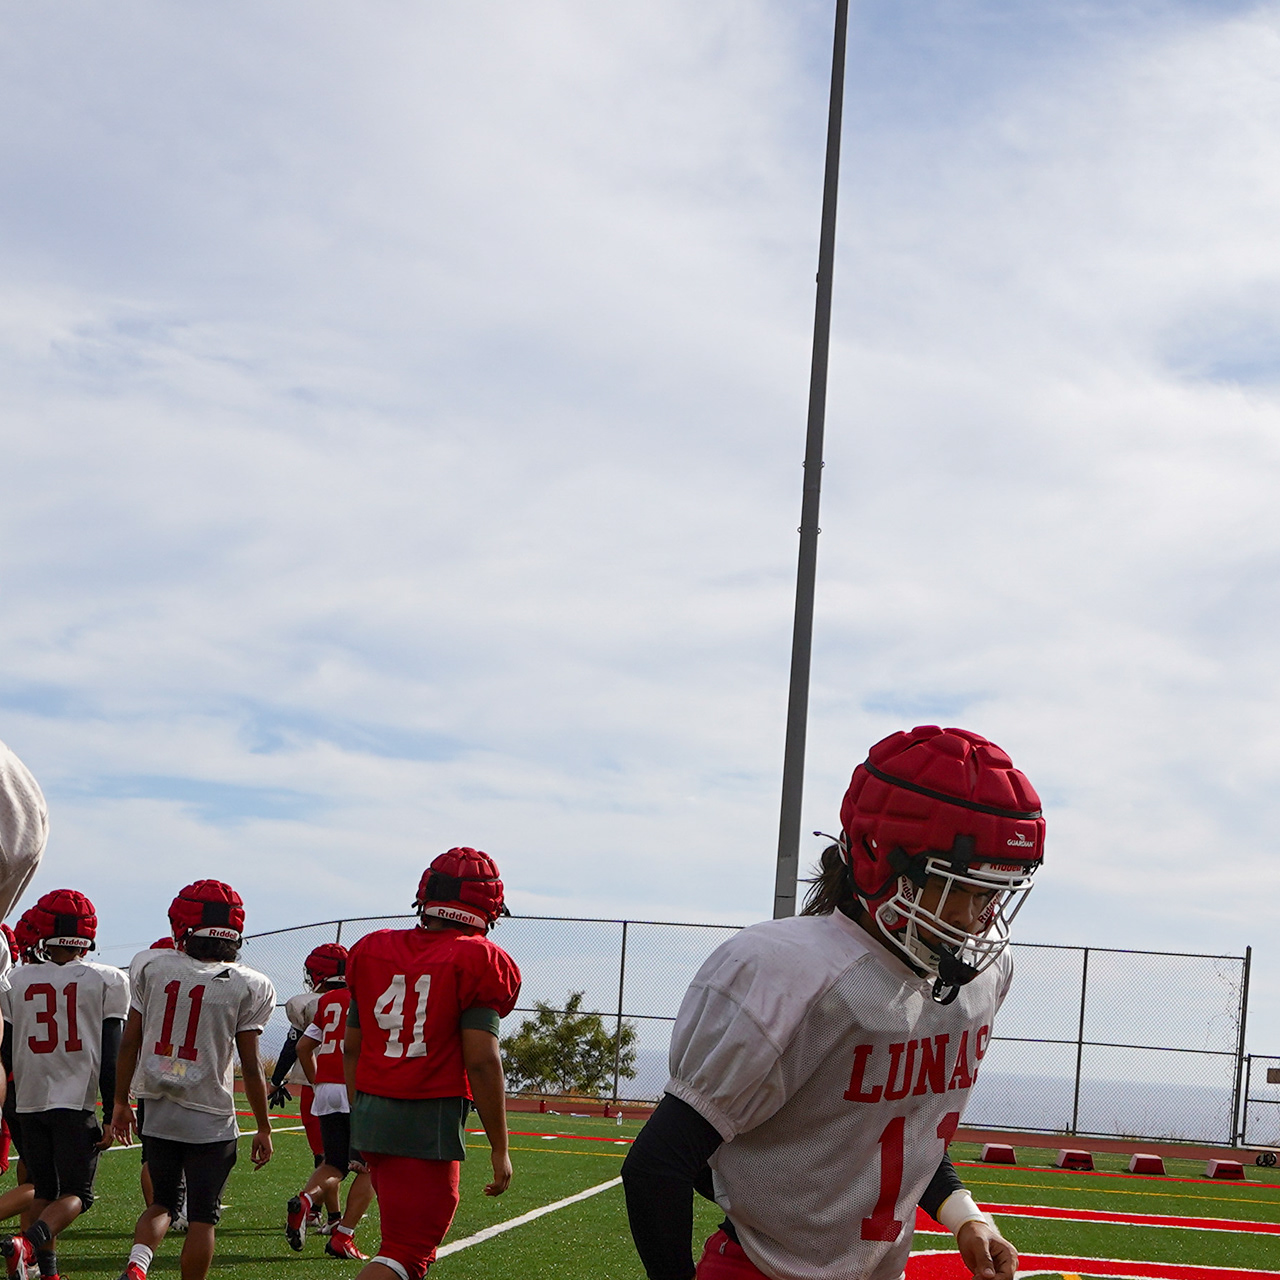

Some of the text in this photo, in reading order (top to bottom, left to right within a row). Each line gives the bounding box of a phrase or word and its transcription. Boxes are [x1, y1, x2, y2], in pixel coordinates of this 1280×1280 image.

[1006, 838, 1034, 848] GUARDIAN
[208, 927, 239, 940] Riddell
[437, 908, 476, 925] Riddell
[58, 938, 89, 947] Riddell
[24, 982, 83, 1054] 31
[153, 979, 206, 1062] 11
[320, 1002, 350, 1055] 2
[373, 974, 432, 1058] 41
